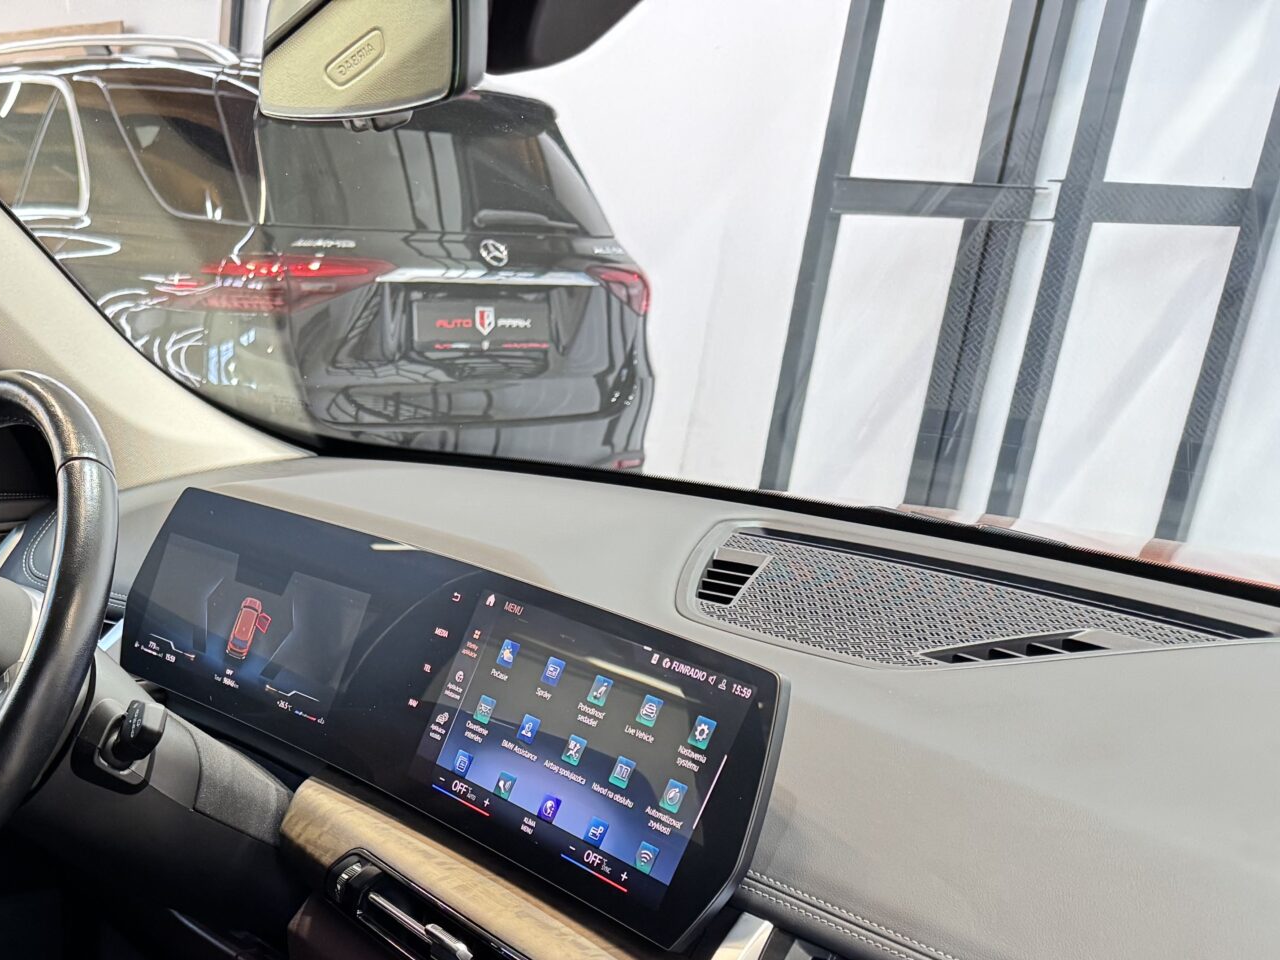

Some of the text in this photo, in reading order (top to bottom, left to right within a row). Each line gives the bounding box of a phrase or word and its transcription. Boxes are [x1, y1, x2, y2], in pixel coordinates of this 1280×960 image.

[435, 318, 532, 329] AUTO PARK
[504, 601, 524, 616] MENU
[434, 627, 449, 638] MEDIA
[424, 663, 432, 673] TEL
[671, 661, 707, 681] FUNRADIO
[731, 683, 752, 699] 15:59
[624, 725, 655, 744] Live Vehicle
[513, 744, 538, 762] Assistance
[451, 780, 468, 795] OFF
[583, 850, 603, 867] OFF
